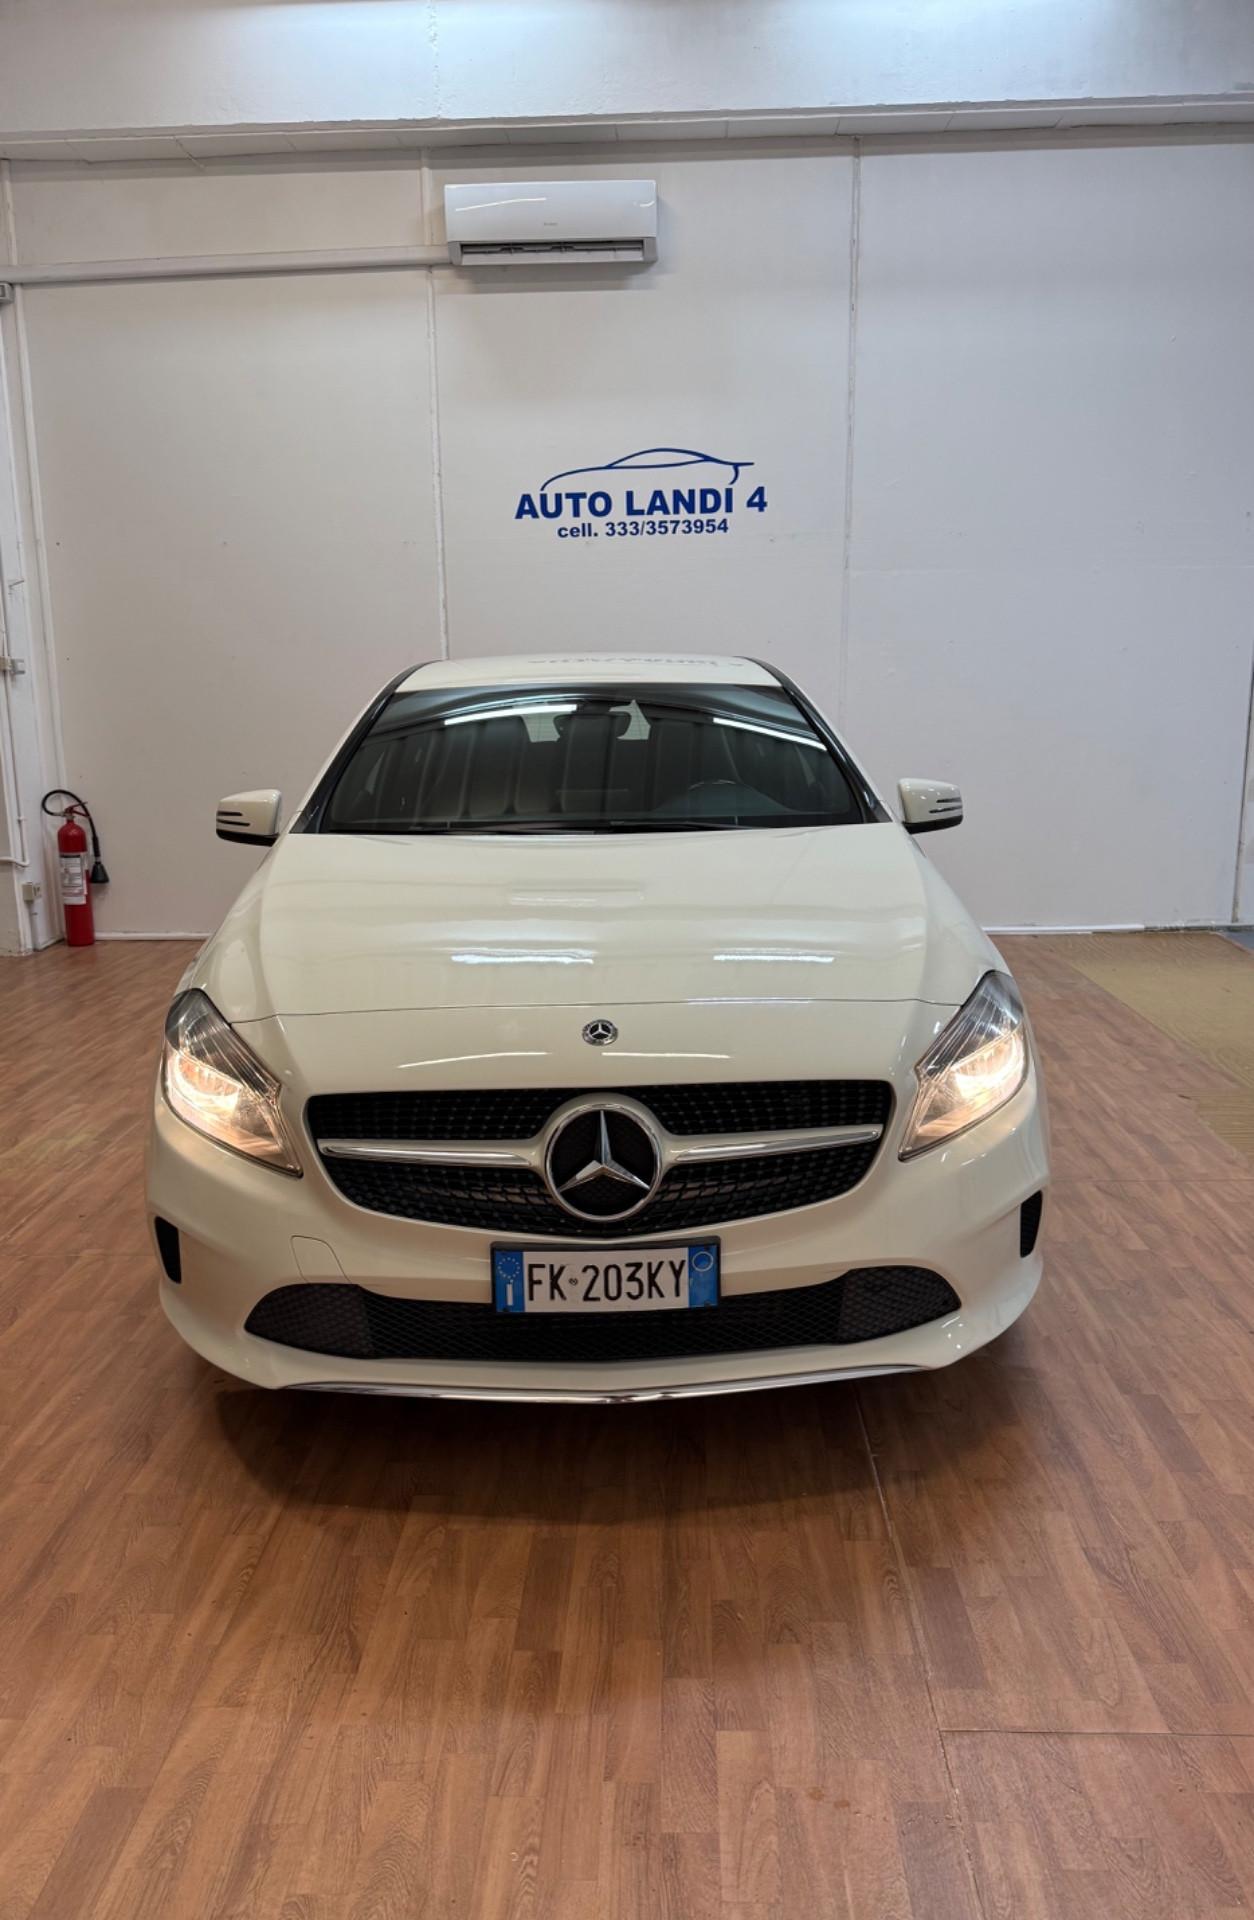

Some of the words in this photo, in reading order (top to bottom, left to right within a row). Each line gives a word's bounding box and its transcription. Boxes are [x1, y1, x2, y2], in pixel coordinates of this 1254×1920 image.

[515, 491, 613, 519] AUTO
[625, 488, 734, 517] LANDI
[746, 486, 768, 512] 4
[557, 522, 599, 538] cell.
[605, 518, 729, 537] 333/3573954
